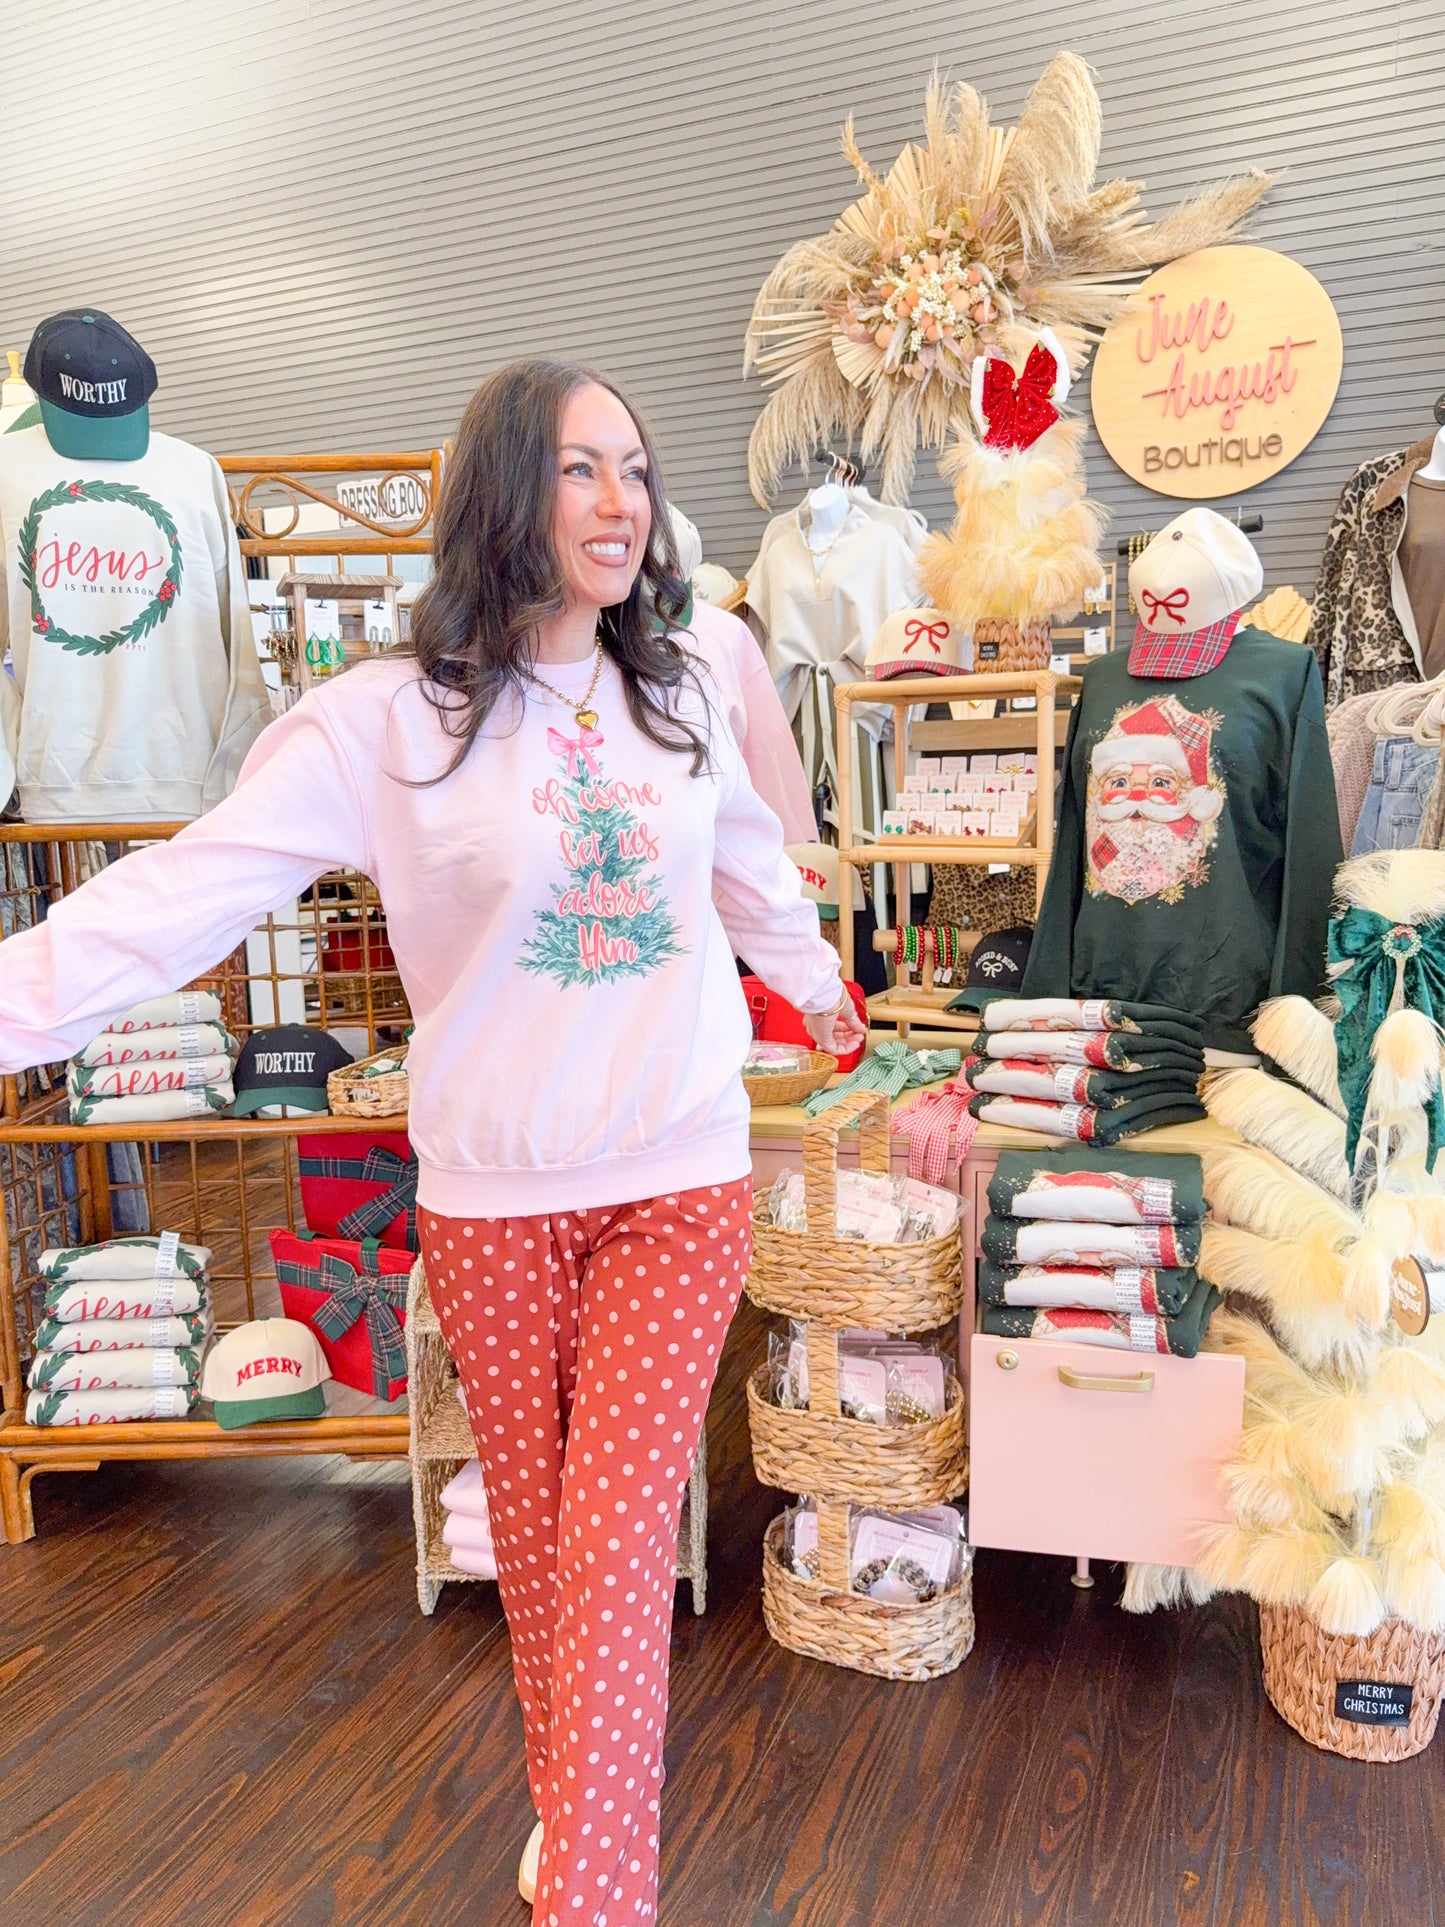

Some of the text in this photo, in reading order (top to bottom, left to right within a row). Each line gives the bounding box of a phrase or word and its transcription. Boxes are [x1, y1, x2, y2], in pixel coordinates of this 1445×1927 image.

[1137, 293, 1235, 362] June
[59, 372, 127, 404] WORTHY
[1142, 336, 1317, 430] August
[1144, 433, 1283, 474] Boutique
[39, 532, 164, 588] jesus
[64, 583, 154, 597] IS THE REASON
[531, 778, 662, 823] oh come
[560, 823, 660, 869] let us
[558, 871, 657, 918] adore
[579, 922, 640, 971] Him
[101, 1066, 224, 1096] jesu
[254, 1052, 316, 1074] WORTHY
[65, 1291, 191, 1320] jesu
[236, 1357, 303, 1388] MERRY
[1343, 1697, 1405, 1715] CHRISTMAS
[1357, 1683, 1394, 1699] MERRY
